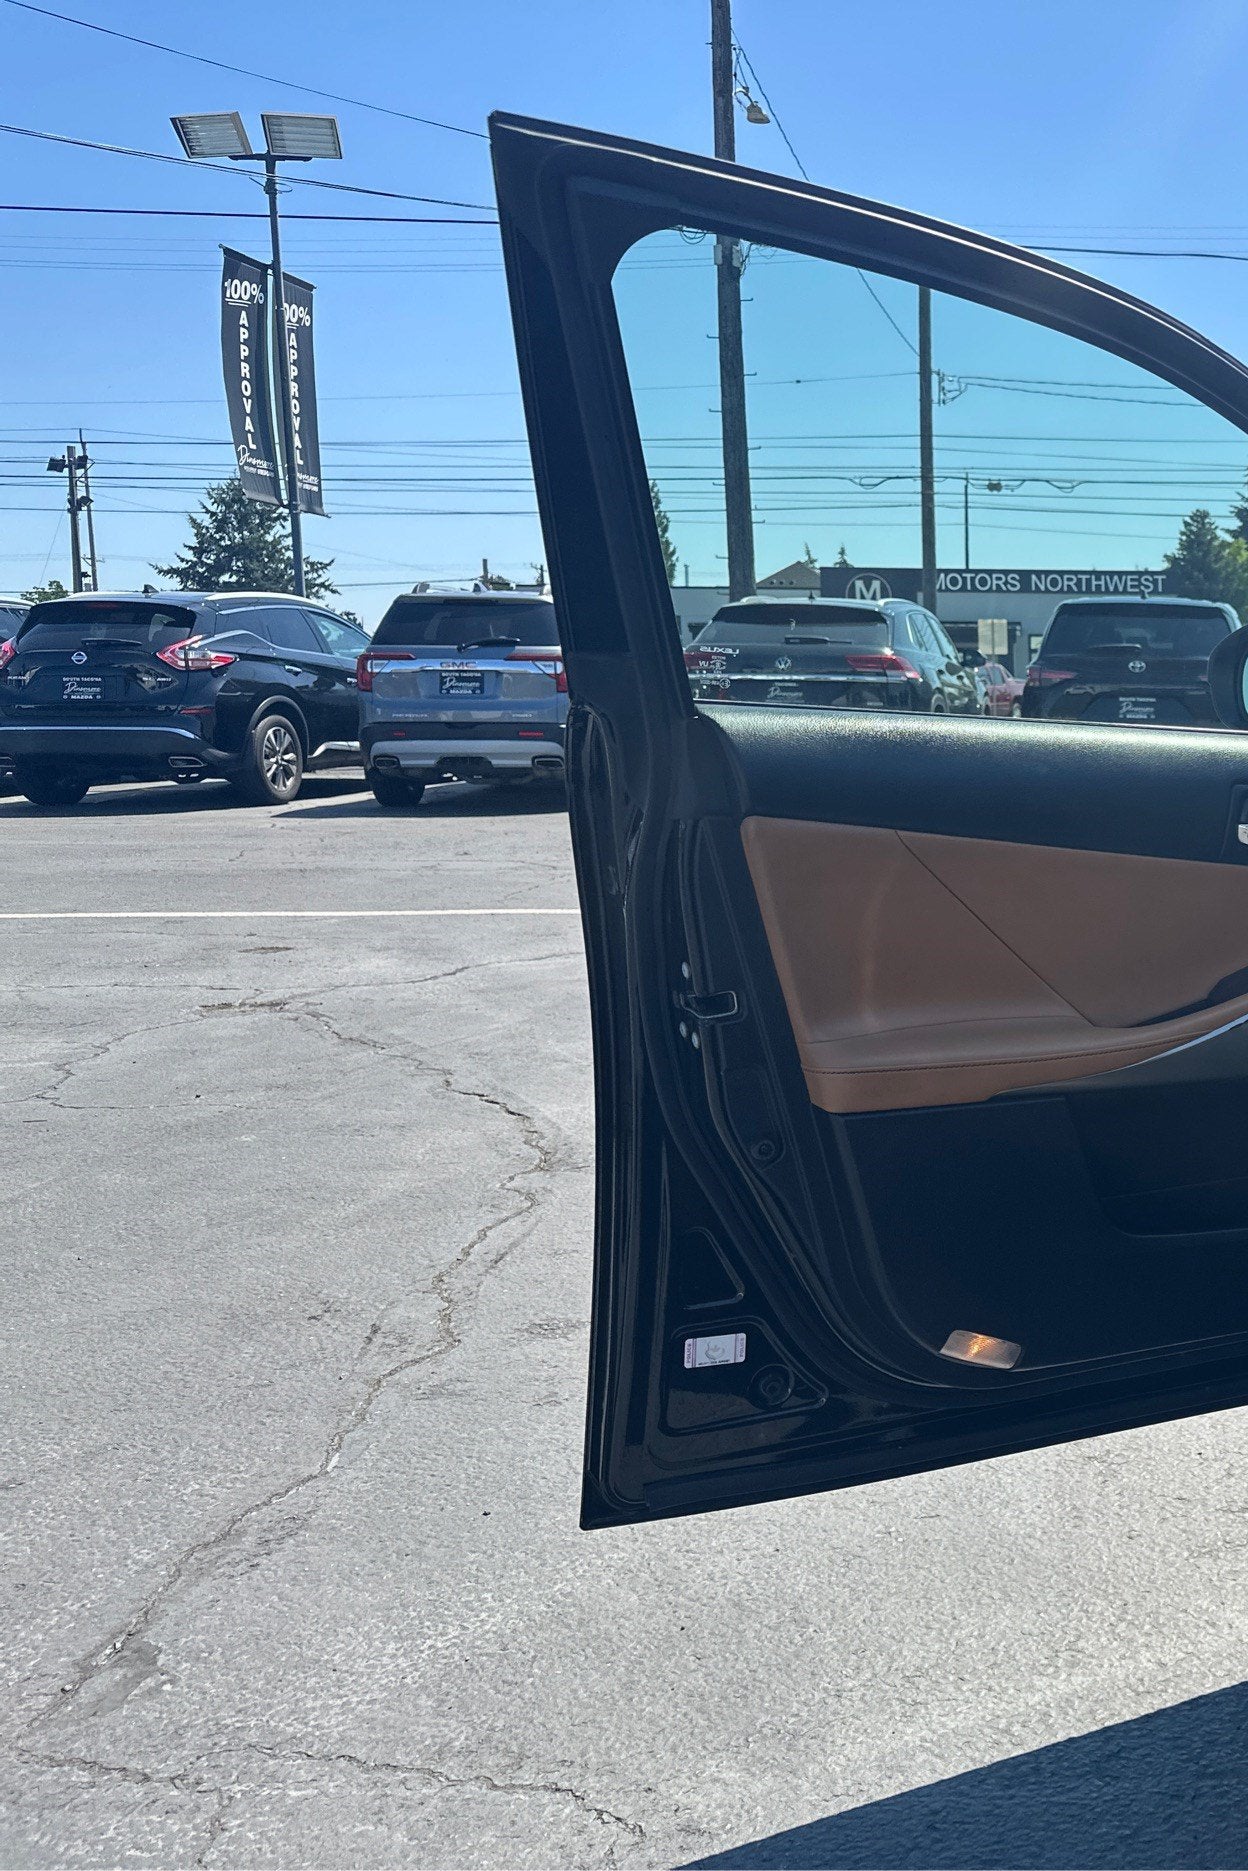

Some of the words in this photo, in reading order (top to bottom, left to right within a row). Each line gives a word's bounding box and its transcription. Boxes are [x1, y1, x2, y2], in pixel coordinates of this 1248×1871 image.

[224, 278, 265, 304] 100%
[239, 310, 257, 450] APPROVAL
[854, 579, 881, 600] M
[935, 573, 1021, 591] MOTORS
[1031, 573, 1167, 593] NORTHWEST
[439, 661, 477, 669] GMC
